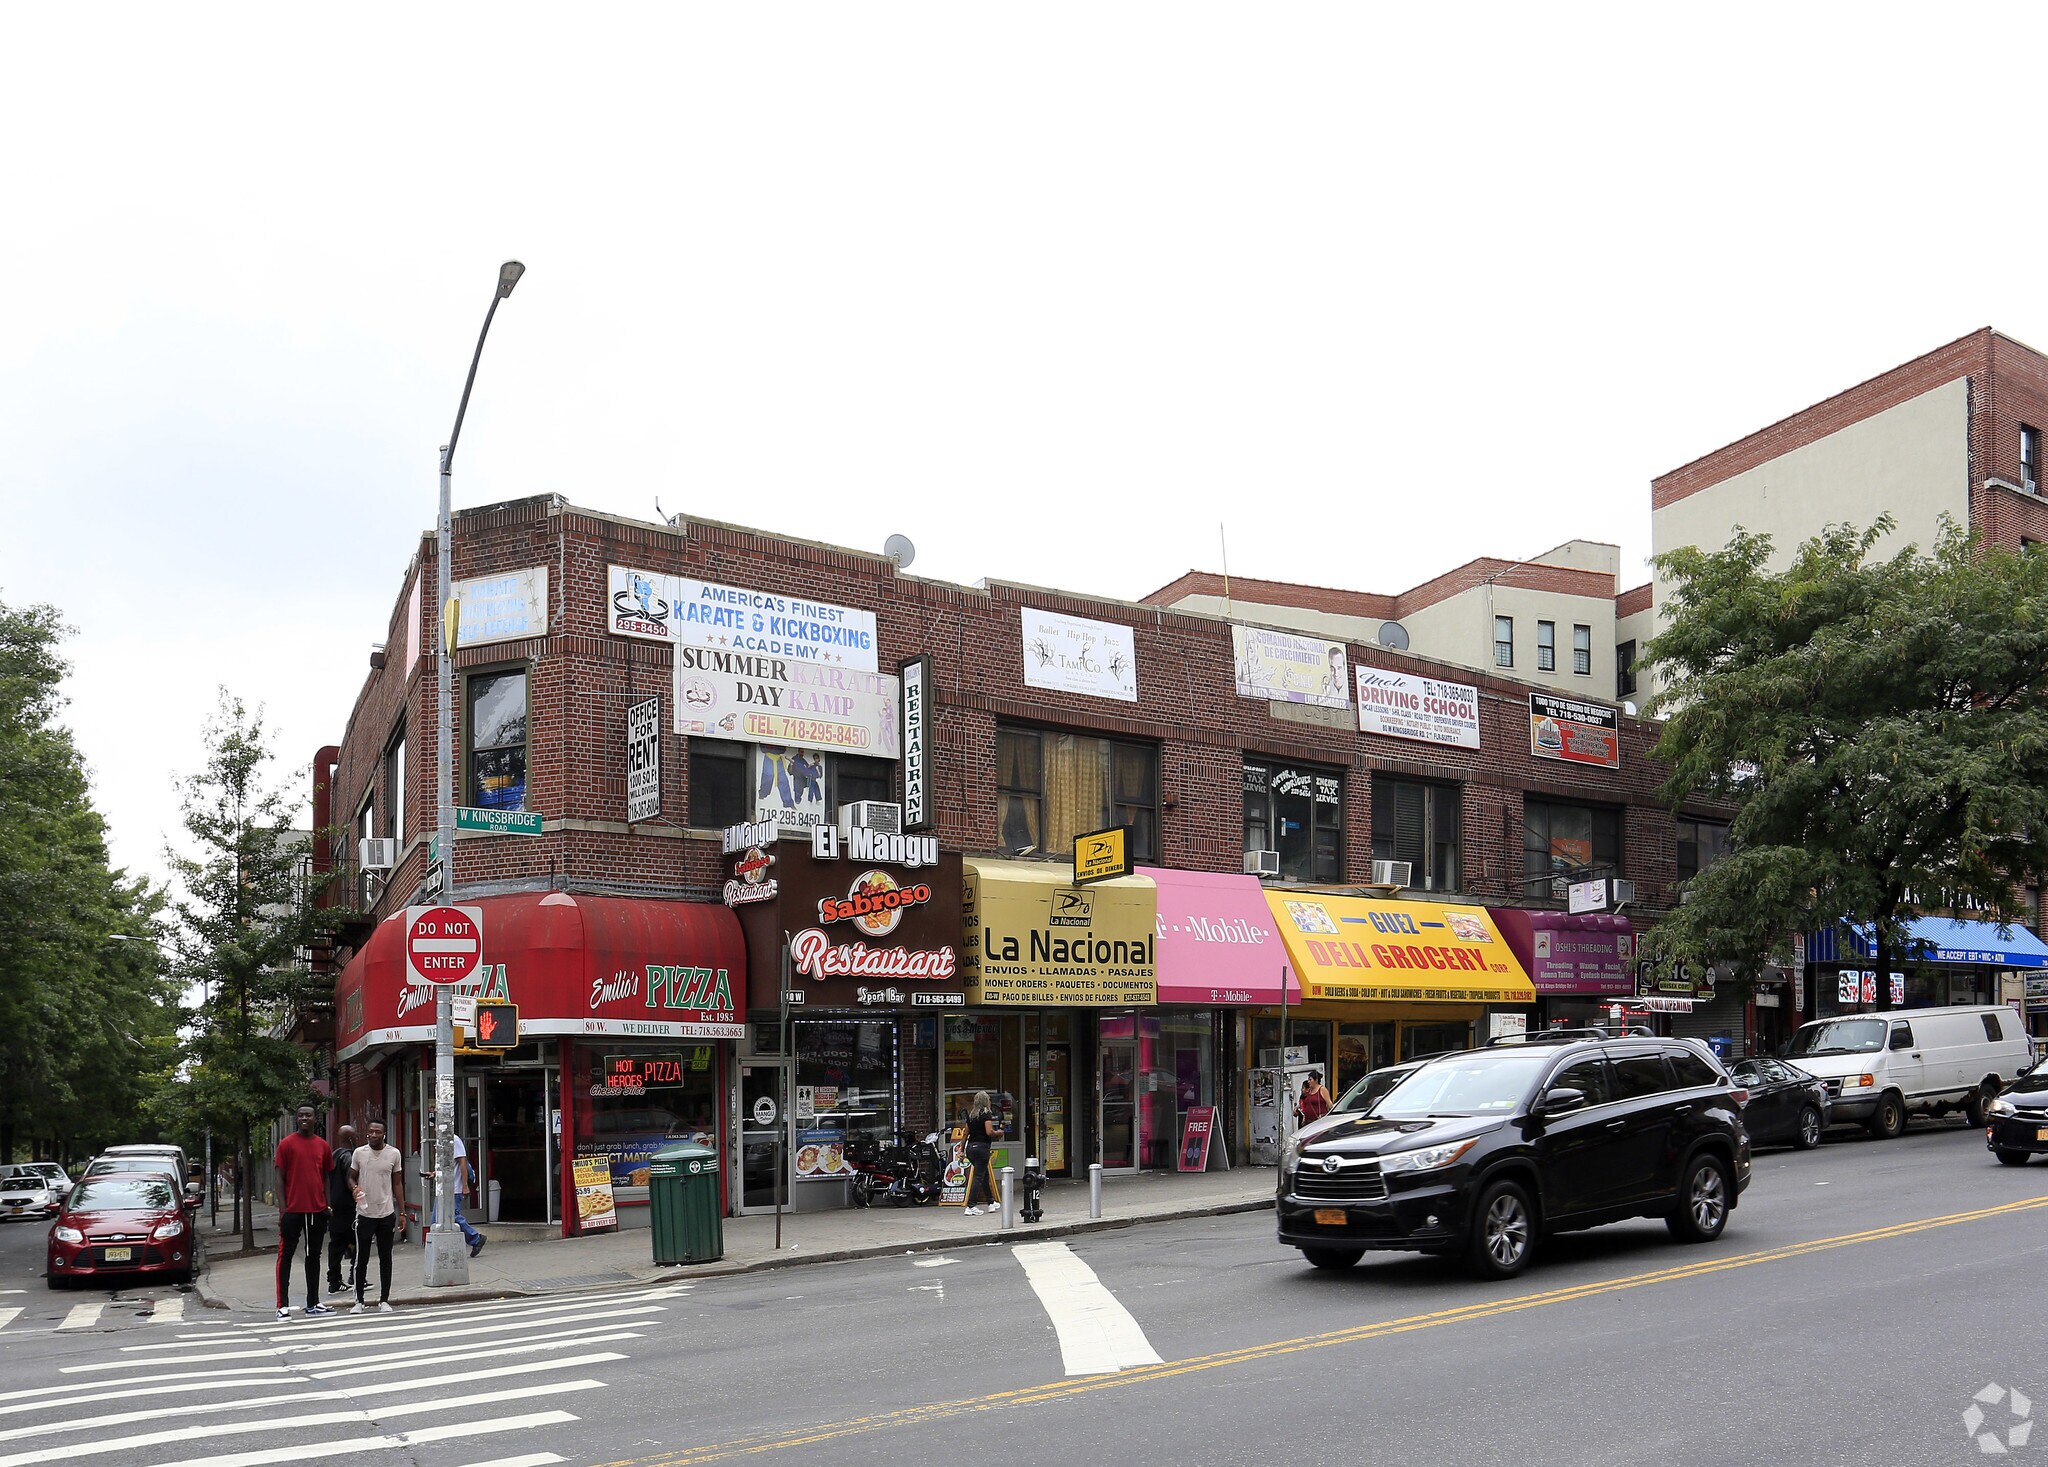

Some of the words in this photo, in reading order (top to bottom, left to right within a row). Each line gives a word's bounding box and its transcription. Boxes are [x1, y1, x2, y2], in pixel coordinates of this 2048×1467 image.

[701, 586, 785, 613] AMERICA'S
[792, 602, 844, 623] FINEST
[617, 619, 666, 636] 295-8450
[673, 600, 745, 630] KARATE
[752, 613, 765, 632] &
[770, 616, 871, 650] KICKBOXING
[1039, 624, 1059, 636] Ballet
[1067, 629, 1080, 641] Hip
[1082, 632, 1097, 645] Hop
[1104, 635, 1120, 647] Jazz
[1257, 631, 1292, 649] COMANDO
[1293, 639, 1327, 654] NACIONAL
[732, 634, 819, 659] ACADEMY
[1264, 646, 1274, 658] DE
[1275, 648, 1321, 666] CRECIMIENTO
[682, 647, 789, 683] SUMMER
[792, 663, 889, 696] KARATE
[736, 681, 784, 707] DAY
[788, 688, 855, 716] KAMP
[1423, 681, 1437, 696] TEL:
[1437, 682, 1474, 703] 718-365-0033
[1360, 685, 1420, 711] DRIVING
[1423, 697, 1476, 720] SCHOOL
[1535, 696, 1549, 707] TODO
[1566, 702, 1584, 713] SEGURO
[1590, 706, 1612, 719] NEGOCIOS
[629, 699, 657, 728] OFFICE
[1545, 707, 1558, 717] TEL
[1559, 710, 1603, 725] 718-530-0037
[634, 721, 653, 739] FOR
[748, 714, 778, 735] TEL.
[783, 719, 867, 746] 718-295-8450
[628, 734, 657, 774] RENT
[906, 684, 922, 824] RESTAURANT
[1247, 773, 1265, 784] TAX
[1315, 776, 1339, 789] INCOME
[1243, 782, 1267, 794] SERVICE
[1319, 786, 1337, 796] TAX
[1315, 793, 1339, 805] SERVICE
[459, 809, 469, 822] W
[472, 810, 536, 827] KINGSBRIDGE
[489, 824, 508, 832] ROAD
[723, 827, 735, 853] El
[735, 819, 778, 850] Mangu
[815, 825, 837, 858] El
[851, 826, 937, 867] Mangu
[735, 854, 776, 876] Sabroso
[1092, 856, 1113, 866] Nacional
[1077, 869, 1094, 878] ENVIOS
[1105, 863, 1124, 873] DINERO
[723, 879, 778, 908] Restaurant
[822, 884, 931, 922] Sabroso
[418, 922, 436, 936] DO
[444, 922, 470, 936] NOT
[1050, 917, 1059, 925] La
[1060, 917, 1091, 926] Nacional
[1367, 911, 1420, 935] GUEZ
[793, 929, 955, 979] Restaurant
[984, 927, 1019, 961] La
[1030, 929, 1154, 965] Nacional
[1555, 943, 1577, 953] OSHI'S
[1577, 943, 1613, 954] THREADING
[423, 956, 466, 970] ENTER
[1305, 940, 1372, 969] DELI
[1370, 943, 1489, 972] GROCERY
[1489, 963, 1512, 974] CORP.
[1937, 950, 1946, 960] WE
[1946, 950, 1966, 961] ACCEPT
[1968, 953, 1978, 961] EBT
[1981, 954, 1991, 962] WIC
[1994, 954, 2005, 963] ATM
[984, 966, 1028, 975] ENVIOS
[1039, 967, 1097, 976] LLAMADAS
[1108, 968, 1153, 977] PASAJES
[1579, 962, 1599, 970] Waxing
[1557, 971, 1575, 979] Tattoo
[1580, 971, 1600, 980] Eyelash
[1600, 972, 1626, 980] Extension
[589, 969, 639, 1010] Emilio's
[645, 965, 735, 1011] PIZZA
[984, 979, 1014, 988] MONEY
[1015, 980, 1048, 989] ORDERS
[1055, 980, 1095, 990] PAQUETES
[1102, 981, 1154, 990] DOCUMENTOS
[1325, 986, 1334, 997] COLD
[1334, 986, 1346, 997] BEERS
[1349, 987, 1359, 998] SODA
[1400, 988, 1422, 999] SANDWICHES
[859, 987, 885, 1005] Sport
[888, 990, 904, 1003] Bar
[1002, 993, 1021, 1002] PAGO
[1021, 994, 1031, 1002] DE
[1032, 993, 1054, 1002] BILLES
[1060, 994, 1084, 1002] ENVIOS
[1085, 994, 1094, 1002] DE
[1094, 994, 1119, 1003] FLORES
[1665, 1000, 1692, 1012] OPENING
[700, 1011, 715, 1022] Est.
[716, 1012, 734, 1023] 1985
[585, 1021, 595, 1032] 80
[596, 1021, 607, 1032] W.
[622, 1023, 636, 1034] WE
[637, 1023, 670, 1035] DELIVER
[680, 1025, 697, 1036] TEL:
[698, 1026, 743, 1037] 718.563.3665
[1714, 1044, 1721, 1054] P
[615, 1059, 634, 1073] HOT
[644, 1062, 682, 1081] PIZZA
[607, 1074, 642, 1087] HEROES
[589, 1083, 622, 1096] Cheese
[622, 1085, 646, 1096] Slice
[555, 1115, 562, 1128] A
[1188, 1121, 1208, 1133] FREE
[576, 1142, 594, 1151] don't
[594, 1143, 605, 1152] just
[606, 1143, 622, 1152] grab
[642, 1141, 658, 1151] grab
[572, 1159, 593, 1167] EMILIO'S
[594, 1157, 608, 1165] PIZZA
[1032, 1189, 1040, 1200] 12
